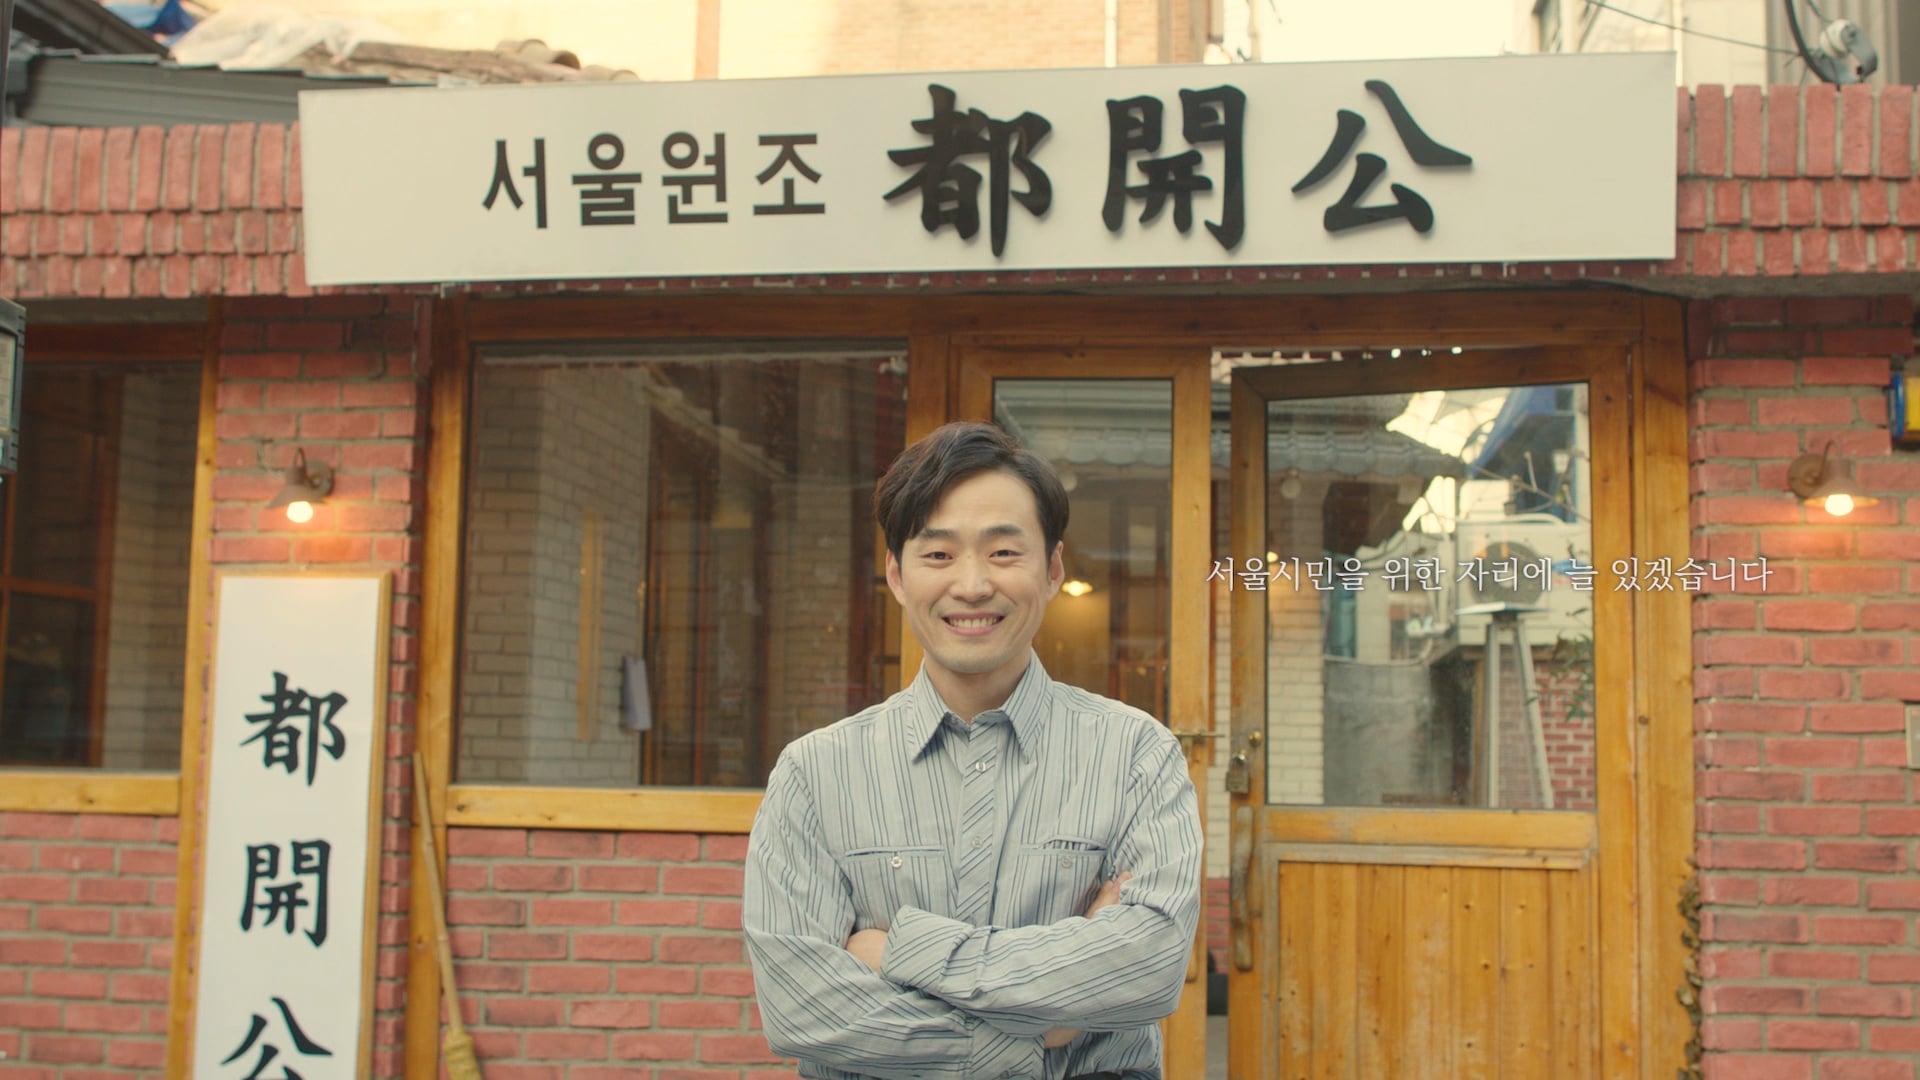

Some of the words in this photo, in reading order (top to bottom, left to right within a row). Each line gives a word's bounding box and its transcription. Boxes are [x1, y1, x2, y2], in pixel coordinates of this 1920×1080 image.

[482, 132, 826, 229] 서울원조
[883, 80, 1473, 257] 都開公
